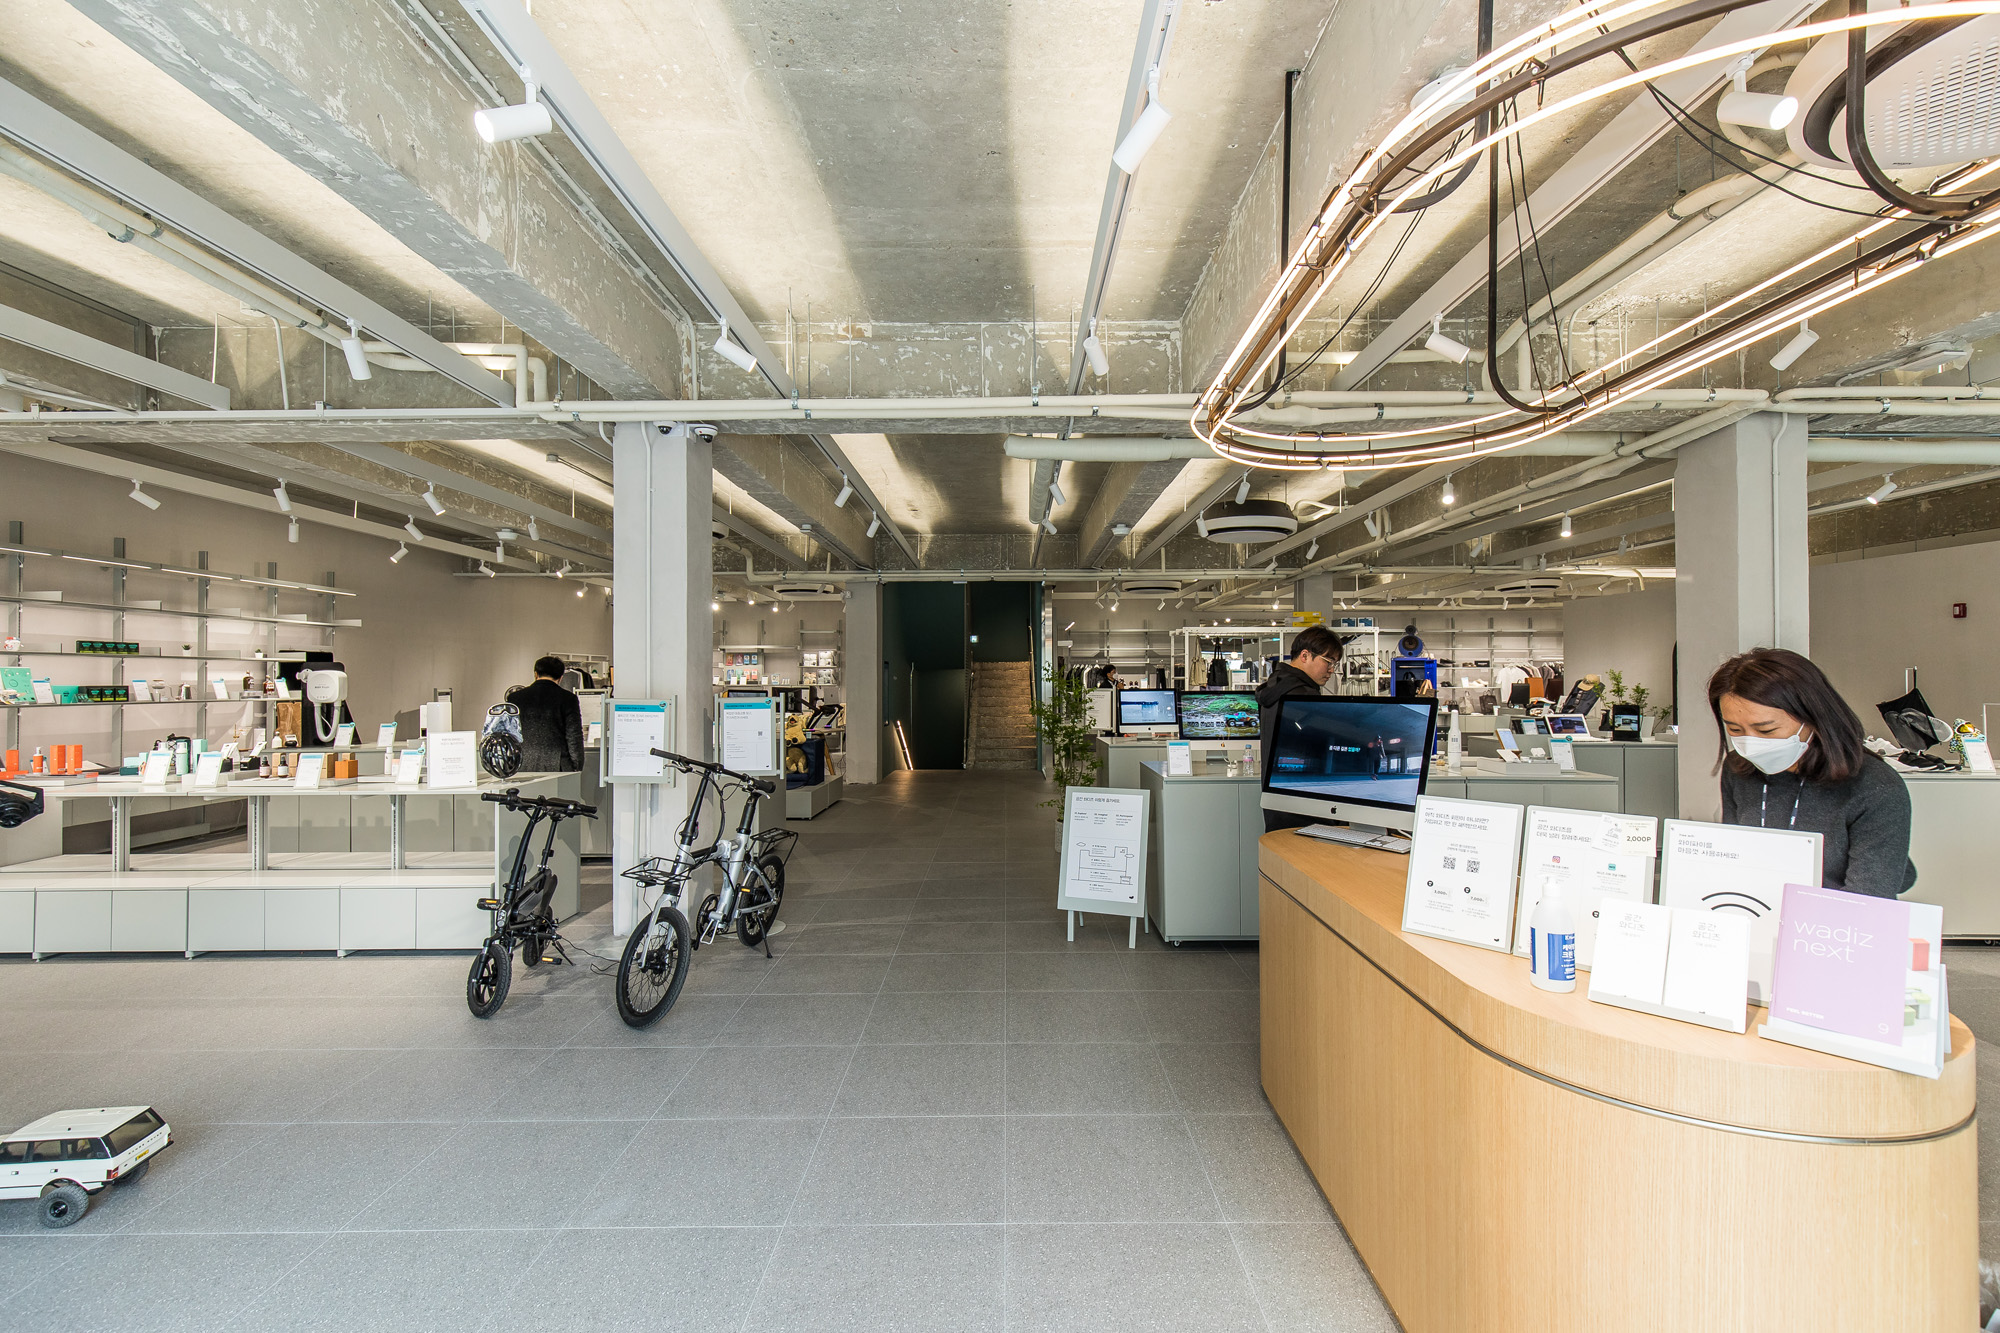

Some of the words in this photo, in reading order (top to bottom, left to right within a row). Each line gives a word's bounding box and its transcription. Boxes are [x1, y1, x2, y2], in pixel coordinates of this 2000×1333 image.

[1626, 835, 1652, 843] 2,000P
[1678, 839, 1713, 849] 와이파이를
[1618, 920, 1646, 932] 와디즈
[1697, 921, 1717, 932] 공간
[1692, 930, 1721, 942] 와디즈
[1793, 919, 1874, 949] wadiz
[1793, 938, 1855, 963] next
[1877, 1022, 1889, 1034] 9
